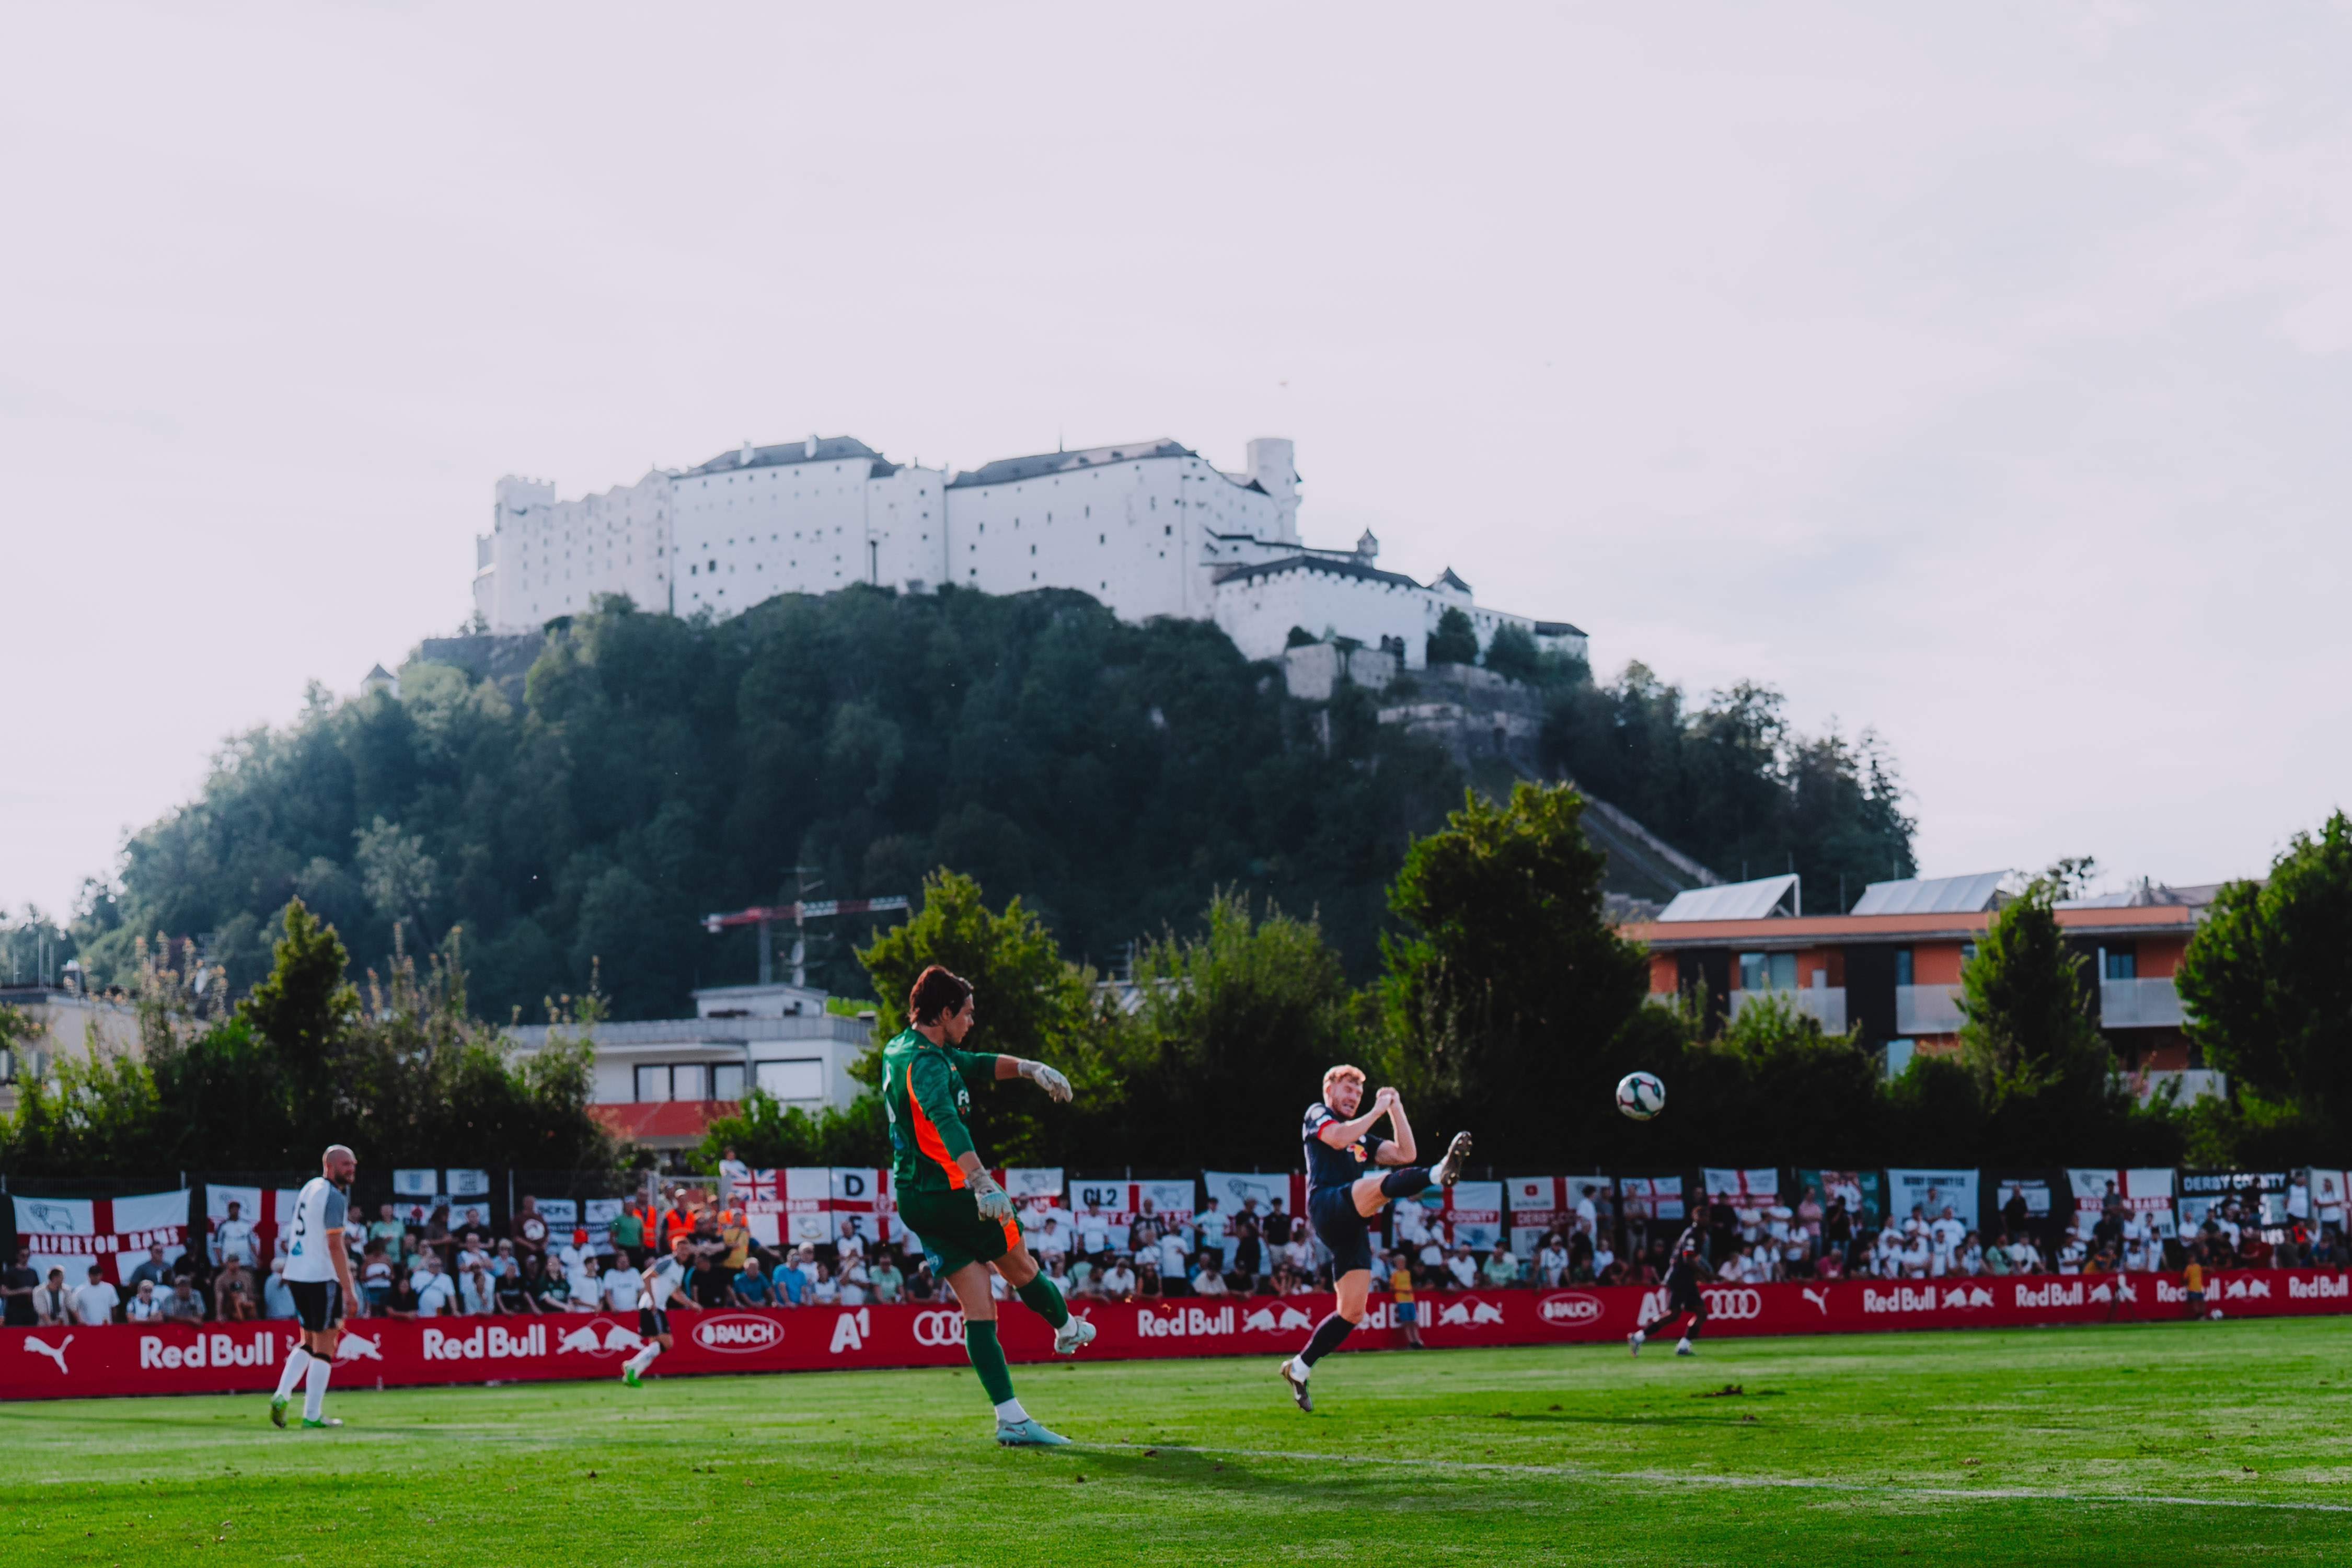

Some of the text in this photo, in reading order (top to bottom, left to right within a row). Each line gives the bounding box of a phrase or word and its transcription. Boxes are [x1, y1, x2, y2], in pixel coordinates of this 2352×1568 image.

[2183, 1174, 2231, 1192] DERBY
[1446, 1209, 1499, 1223] COUNTY
[2134, 1197, 2168, 1210] RAMS
[296, 1202, 306, 1236] 5
[29, 1227, 180, 1254] ALFRETON RAMS
[1863, 1285, 1936, 1313] Red Bull
[2015, 1281, 2083, 1308] Red Bull
[2288, 1274, 2349, 1299] Red Bull
[1137, 1305, 1235, 1338] Red Bull
[1554, 1301, 1597, 1318] RAUCH
[422, 1323, 547, 1361] Red Bull
[716, 1323, 775, 1344] RAUCH
[829, 1307, 870, 1354] A1
[140, 1331, 273, 1369] Red Bull
